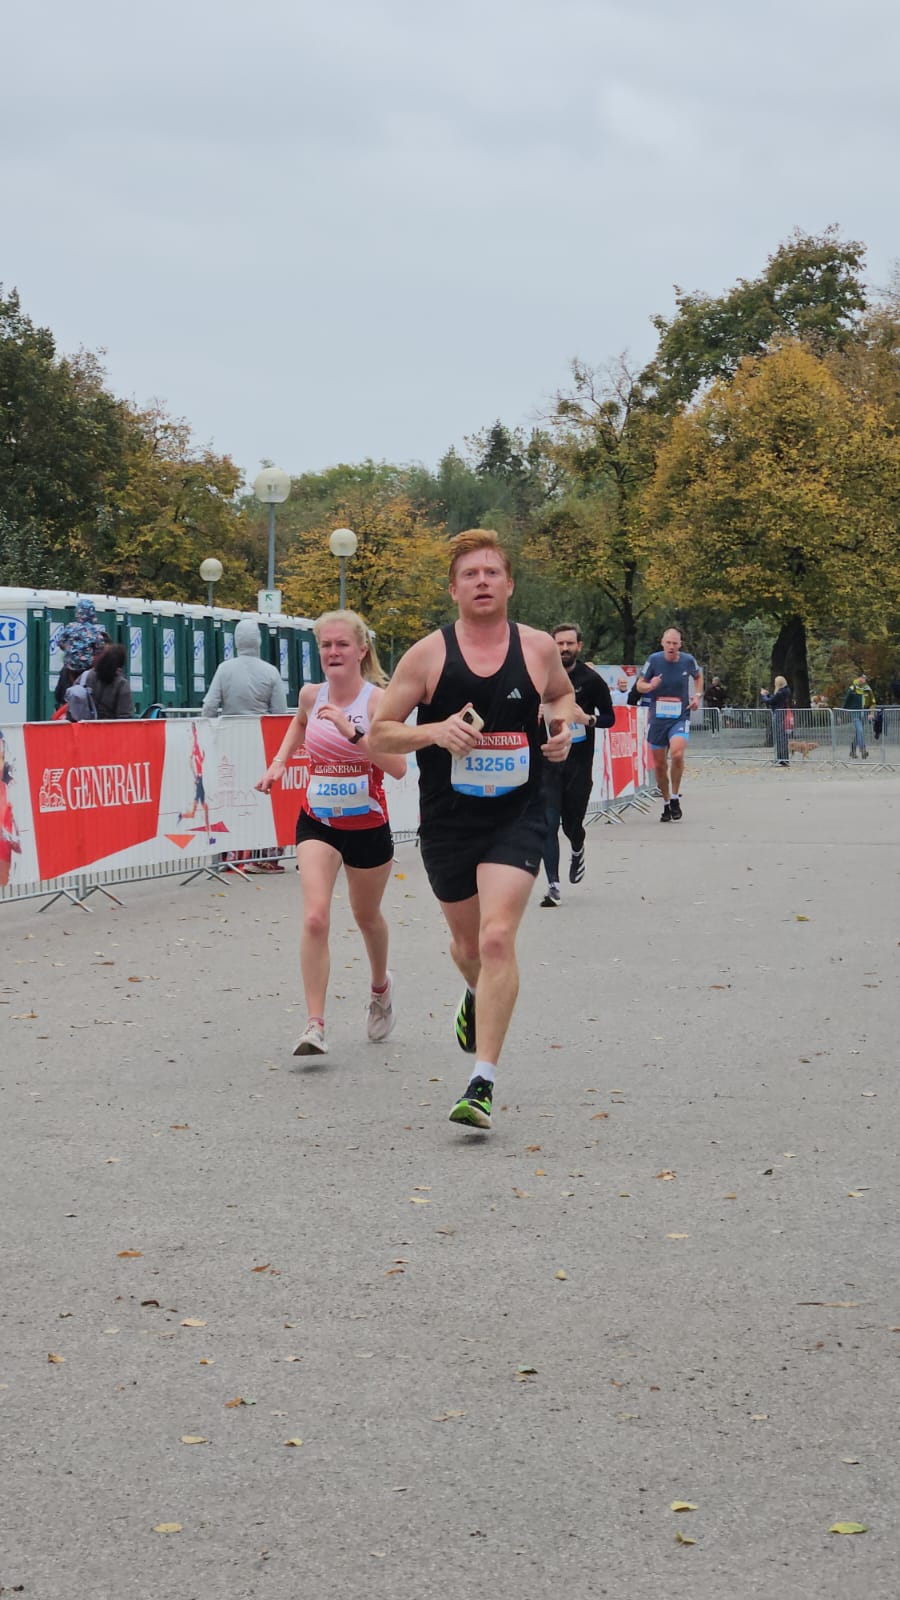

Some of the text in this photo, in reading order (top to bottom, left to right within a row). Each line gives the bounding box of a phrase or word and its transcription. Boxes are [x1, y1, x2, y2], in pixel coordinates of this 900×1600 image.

[323, 764, 362, 774] GENERALI
[465, 756, 516, 772] 13256
[66, 762, 153, 810] GENERALI
[316, 780, 367, 796] 12580 F
